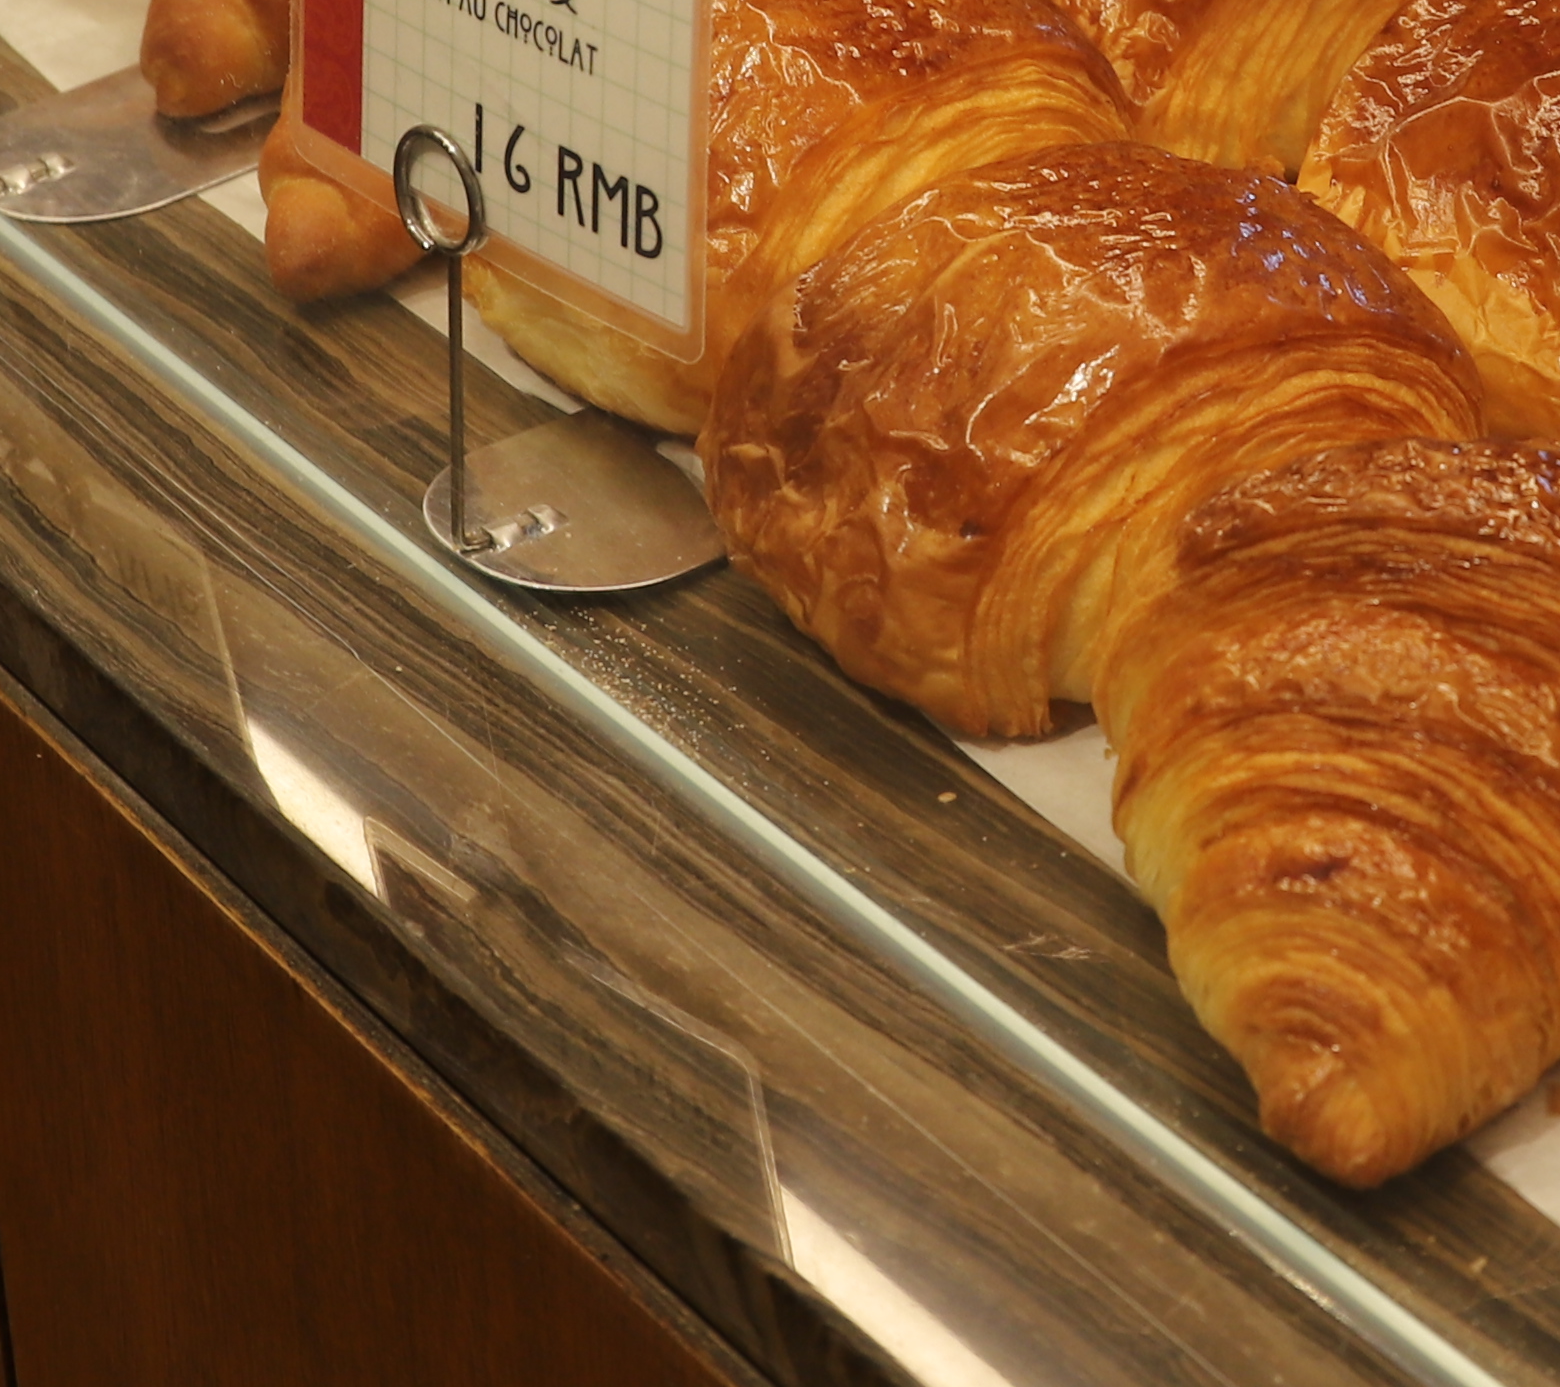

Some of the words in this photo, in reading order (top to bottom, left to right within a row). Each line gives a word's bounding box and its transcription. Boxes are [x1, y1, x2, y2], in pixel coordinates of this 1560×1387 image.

[495, 1, 598, 76] CHOCOLAT
[475, 102, 531, 194] 16
[557, 144, 663, 259] RMB
